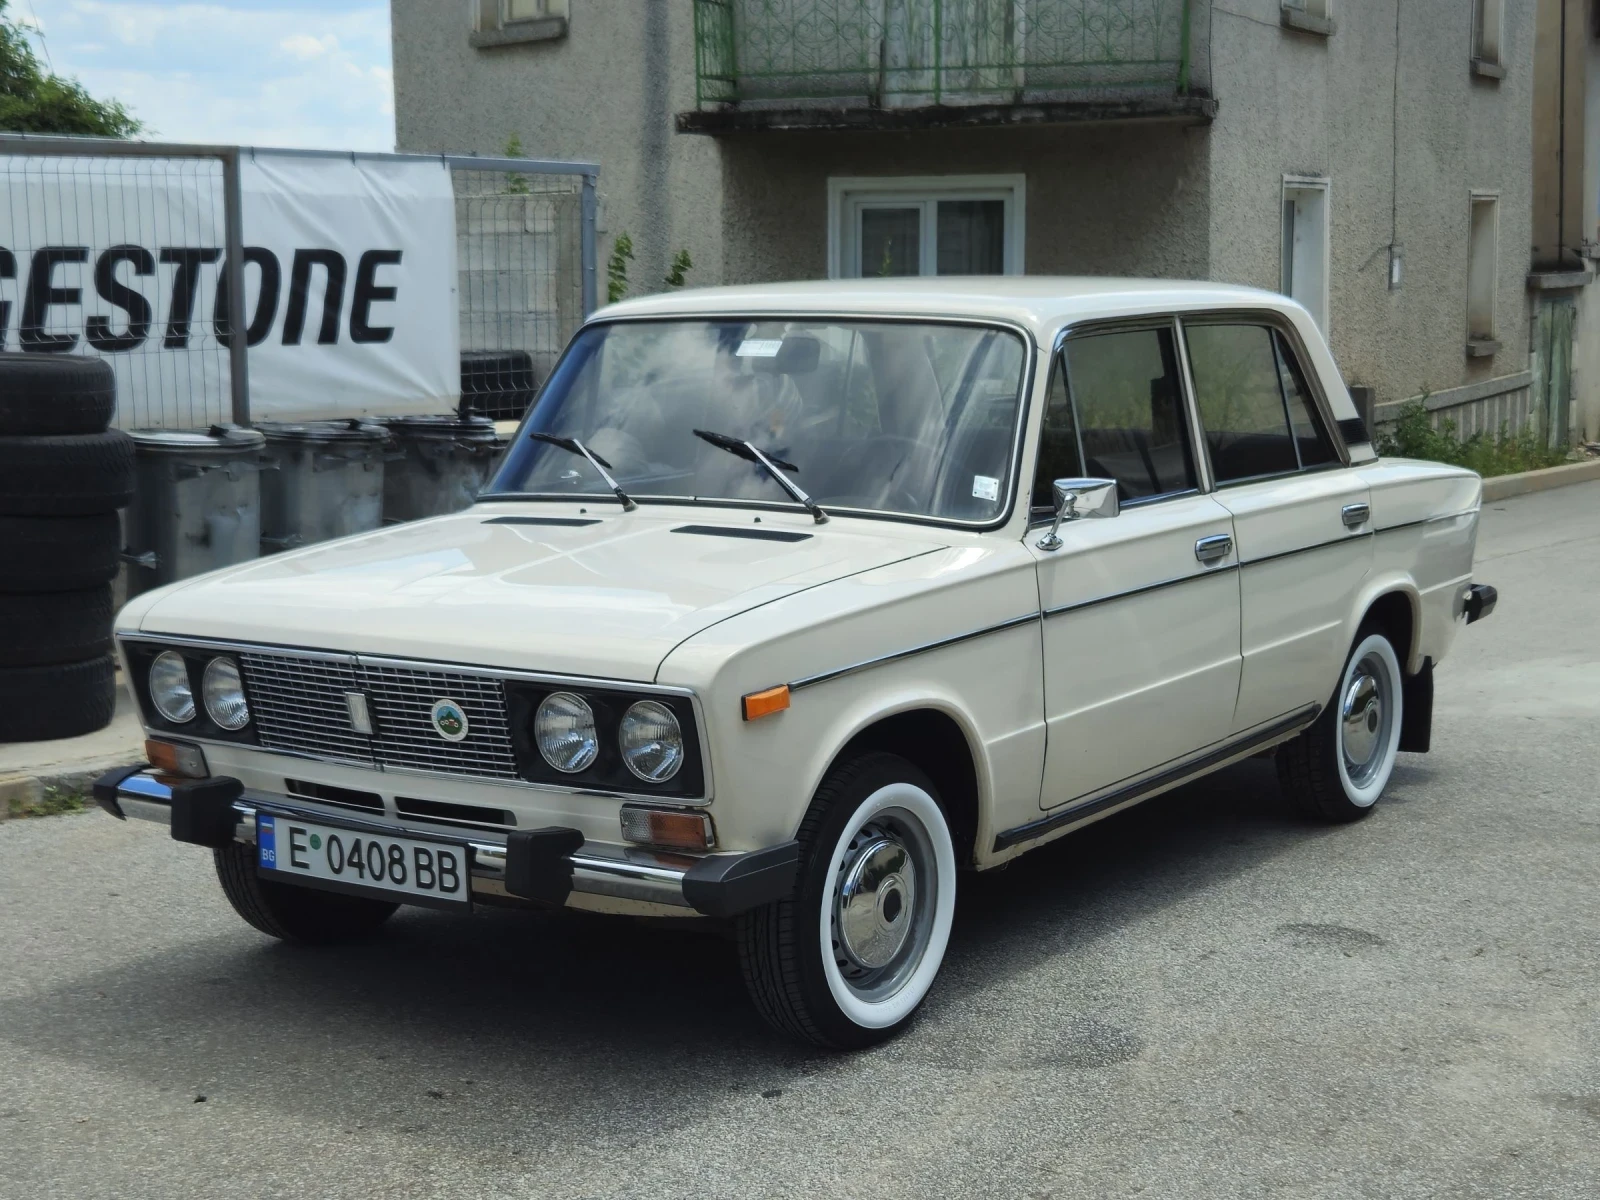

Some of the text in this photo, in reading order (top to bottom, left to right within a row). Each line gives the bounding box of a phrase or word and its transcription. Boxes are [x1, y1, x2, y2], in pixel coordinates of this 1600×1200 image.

[0, 244, 402, 353] ESTONE
[262, 848, 275, 862] BG
[289, 826, 310, 870] E
